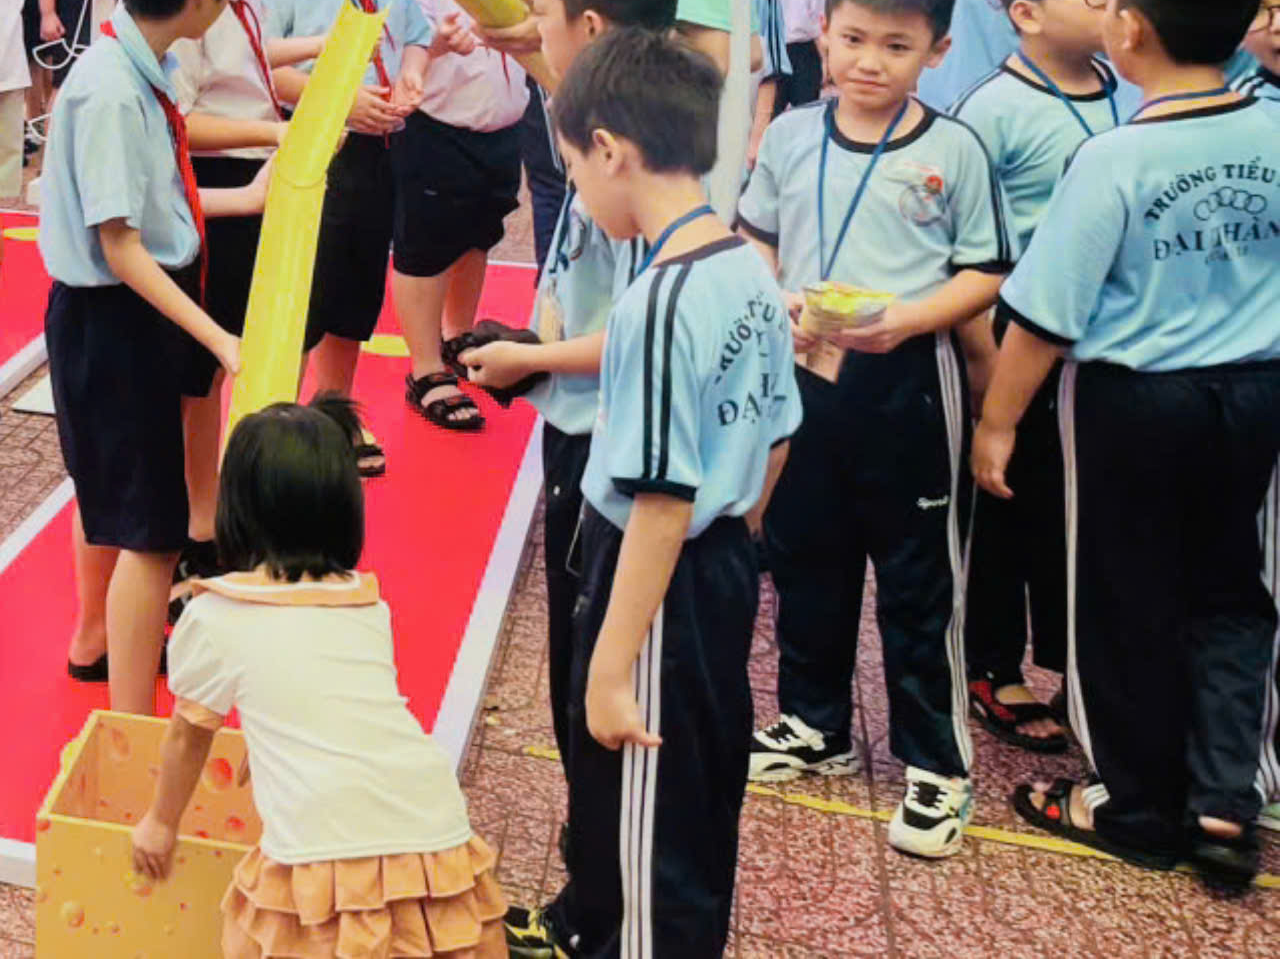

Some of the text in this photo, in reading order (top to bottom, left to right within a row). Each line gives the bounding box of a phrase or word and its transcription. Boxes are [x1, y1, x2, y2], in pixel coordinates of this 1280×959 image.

[1143, 155, 1276, 221] TRƯỜNG TIỂU
[1153, 230, 1205, 260] ĐẠI
[1209, 216, 1280, 248] THÀN
